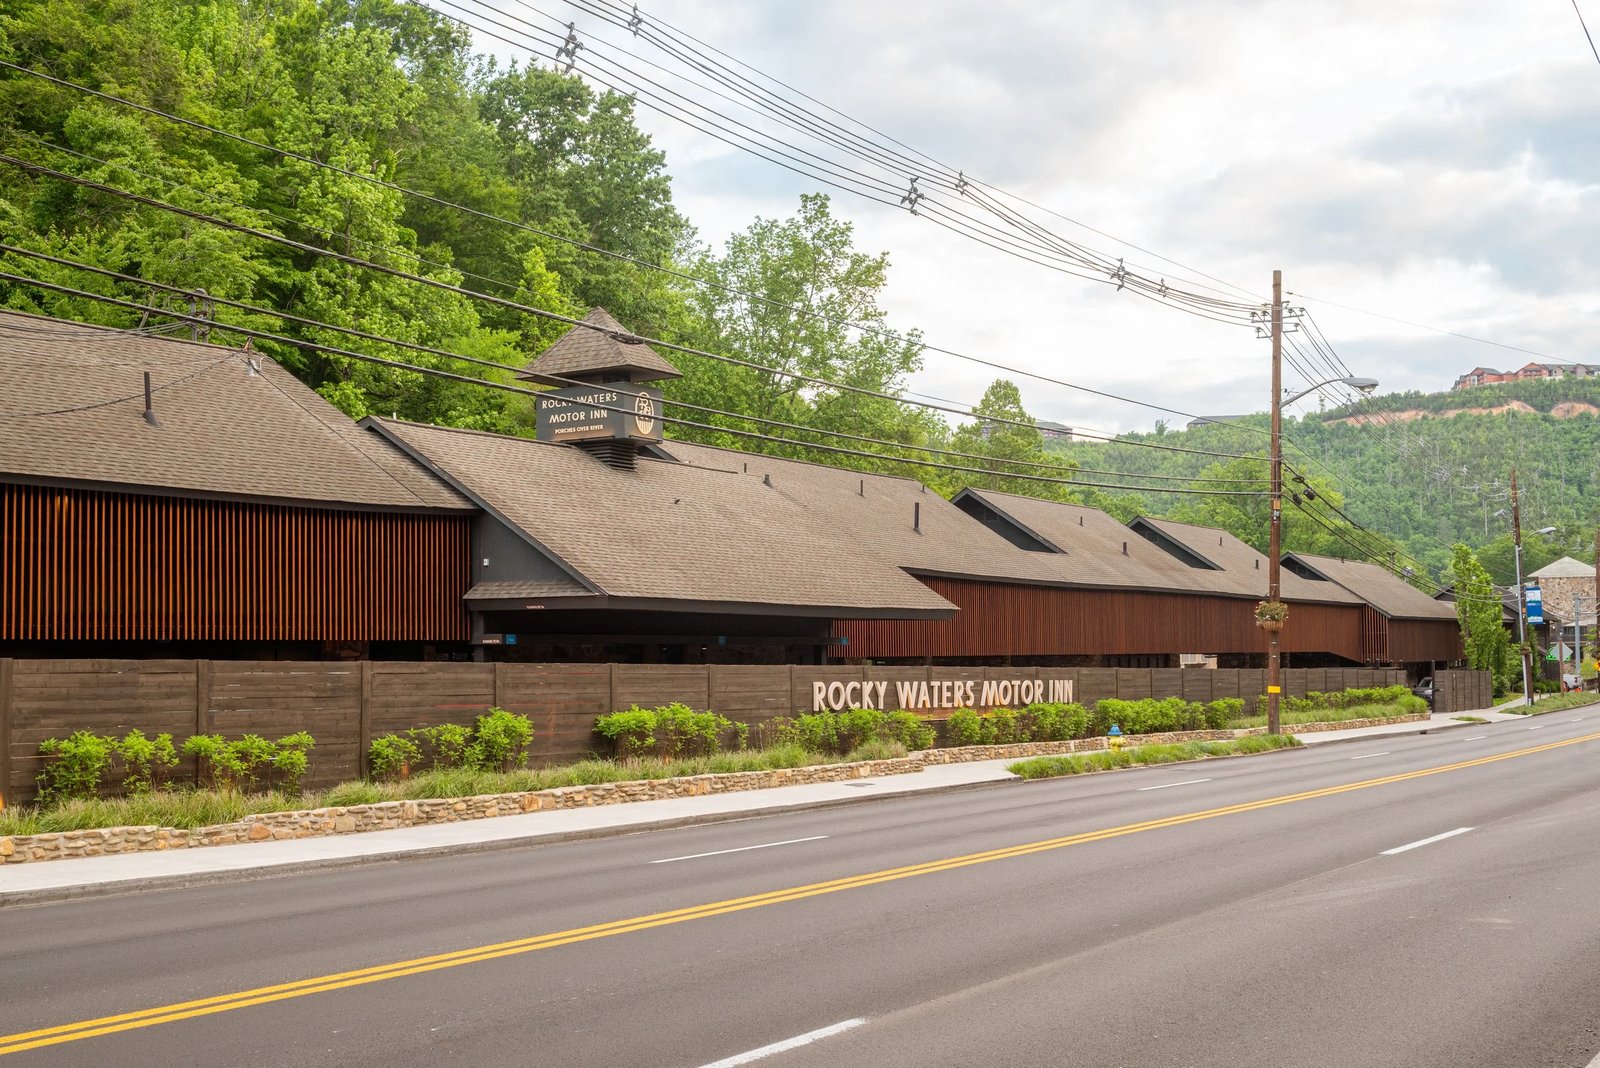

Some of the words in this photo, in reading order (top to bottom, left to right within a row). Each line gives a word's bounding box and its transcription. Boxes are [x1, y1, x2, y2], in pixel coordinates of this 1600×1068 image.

[576, 393, 617, 404] WATERS
[549, 411, 585, 423] MOTOR
[590, 409, 607, 419] INN
[813, 681, 888, 712] ROCKY
[896, 680, 975, 709] WATERS
[980, 679, 1044, 706] MOTOR
[1049, 679, 1073, 704] INN
